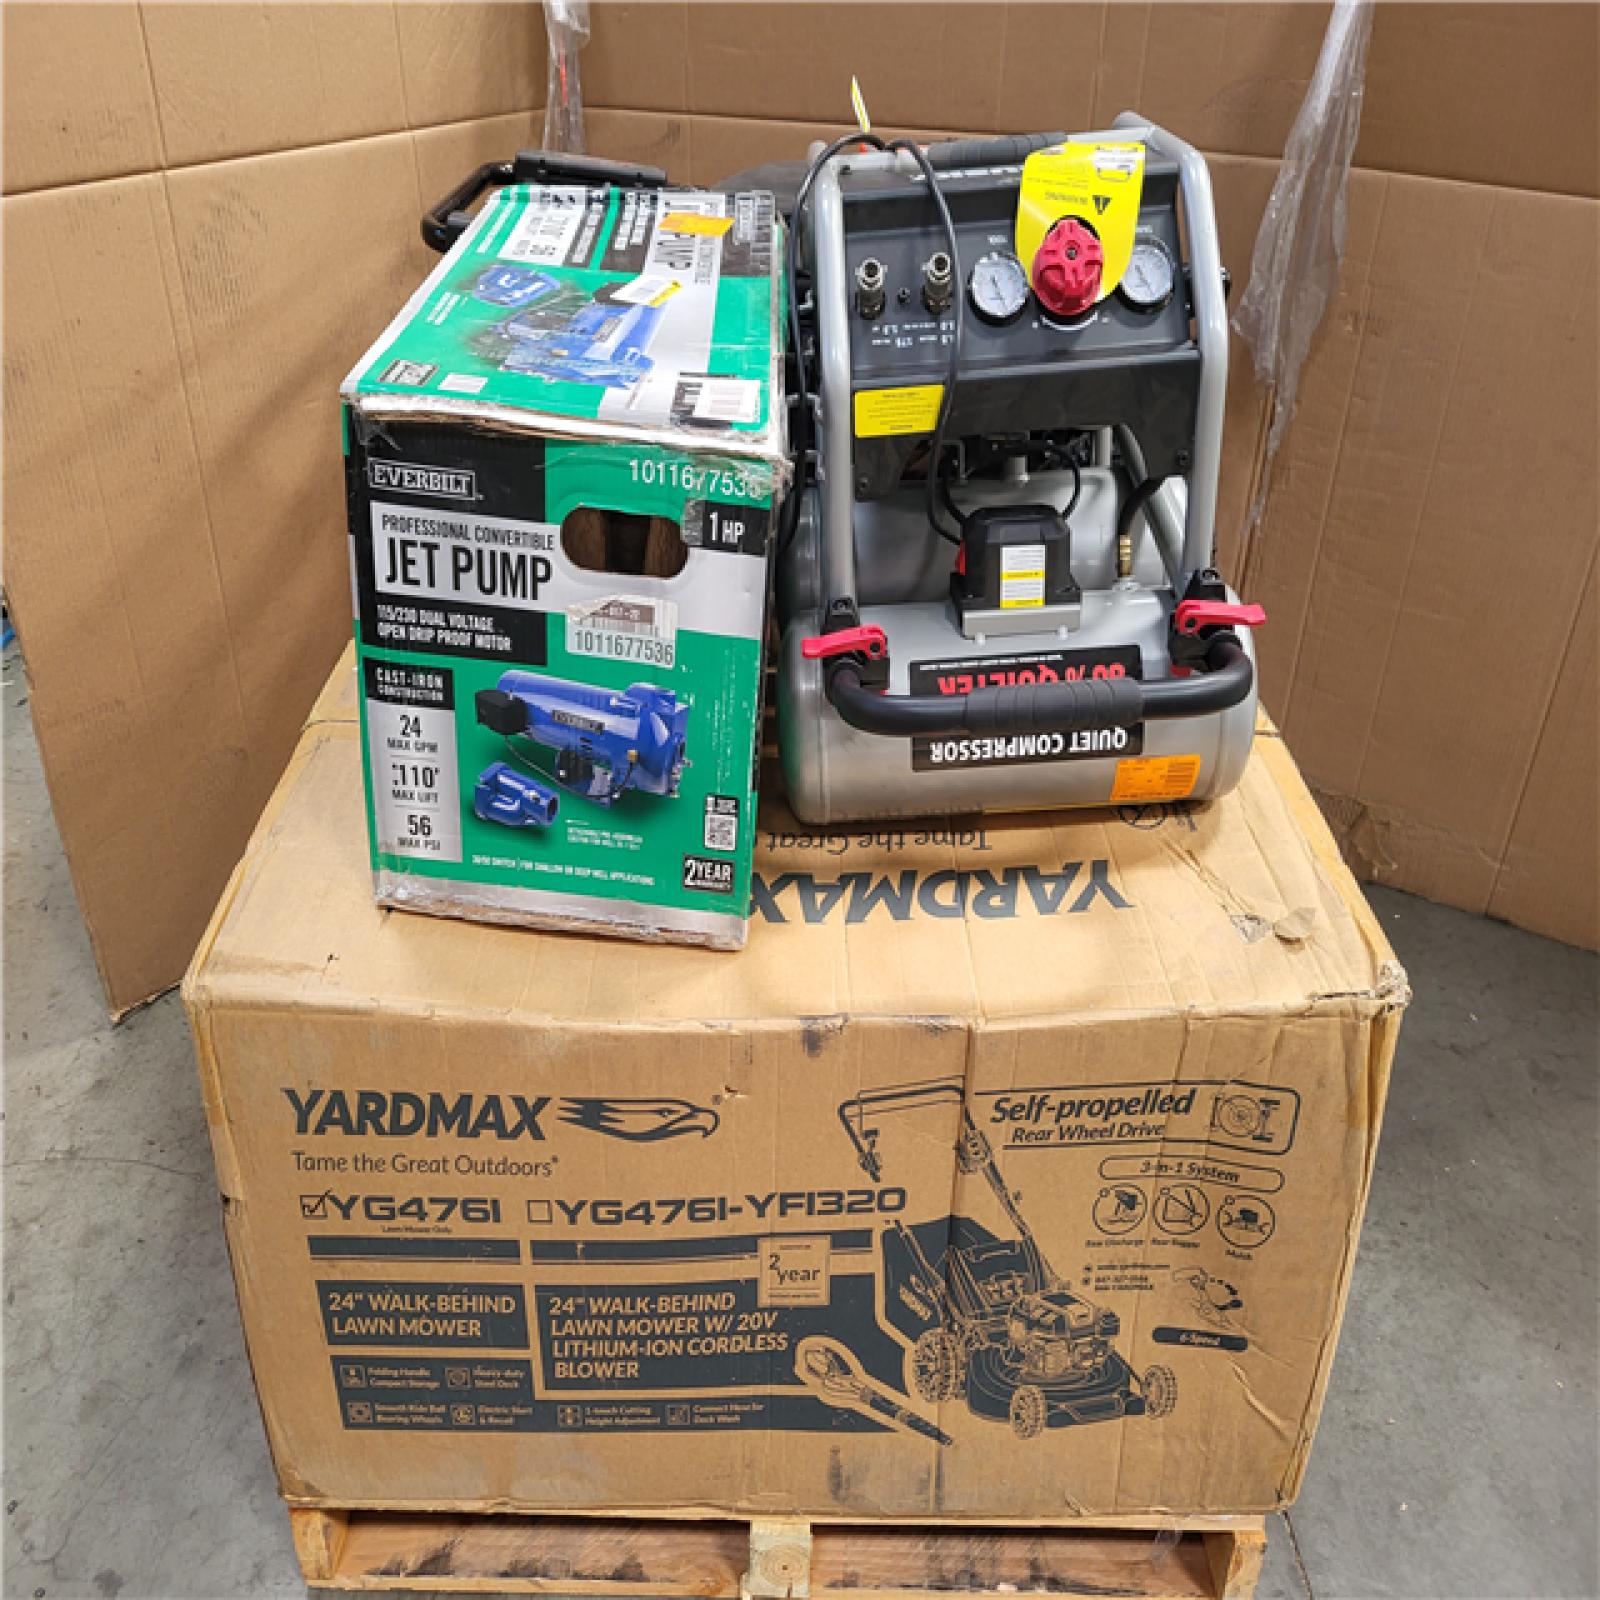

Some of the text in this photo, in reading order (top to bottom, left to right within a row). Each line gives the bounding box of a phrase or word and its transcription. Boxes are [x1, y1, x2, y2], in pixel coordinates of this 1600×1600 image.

[374, 464, 471, 493] EVERBILT
[382, 514, 556, 551] PROFESSIONAL CONVERTIBLE
[710, 511, 745, 544] 1 HP
[385, 537, 552, 600] JET PUMP
[575, 629, 674, 666] 1011677536
[400, 714, 422, 738] 24
[387, 737, 410, 750] MAX
[929, 724, 1128, 763] QUIET COMPRESSOR
[407, 814, 431, 837] 56
[766, 831, 849, 856] Great
[856, 829, 905, 853] the
[914, 828, 992, 851] Tame
[751, 859, 1135, 925] YARDMAX
[284, 1088, 553, 1141] YARDMAX
[990, 1088, 1197, 1124] Self-propelled
[1012, 1121, 1166, 1143] Rear Wheel Drive
[292, 1151, 348, 1172] Tame
[354, 1152, 386, 1173] the
[391, 1153, 449, 1175] Great
[1187, 1162, 1240, 1183] System
[769, 1253, 821, 1286] 2 year
[329, 1292, 516, 1314] 24" WALK-BEHIND
[550, 1292, 736, 1316] 24" WALK-BEHIND
[332, 1316, 482, 1337] LAWN MOWER
[551, 1312, 779, 1336] LAWN MOWER W/ 20V
[552, 1333, 788, 1359] LITHIUM-ION CORDLESS
[554, 1360, 640, 1379] BLOWER
